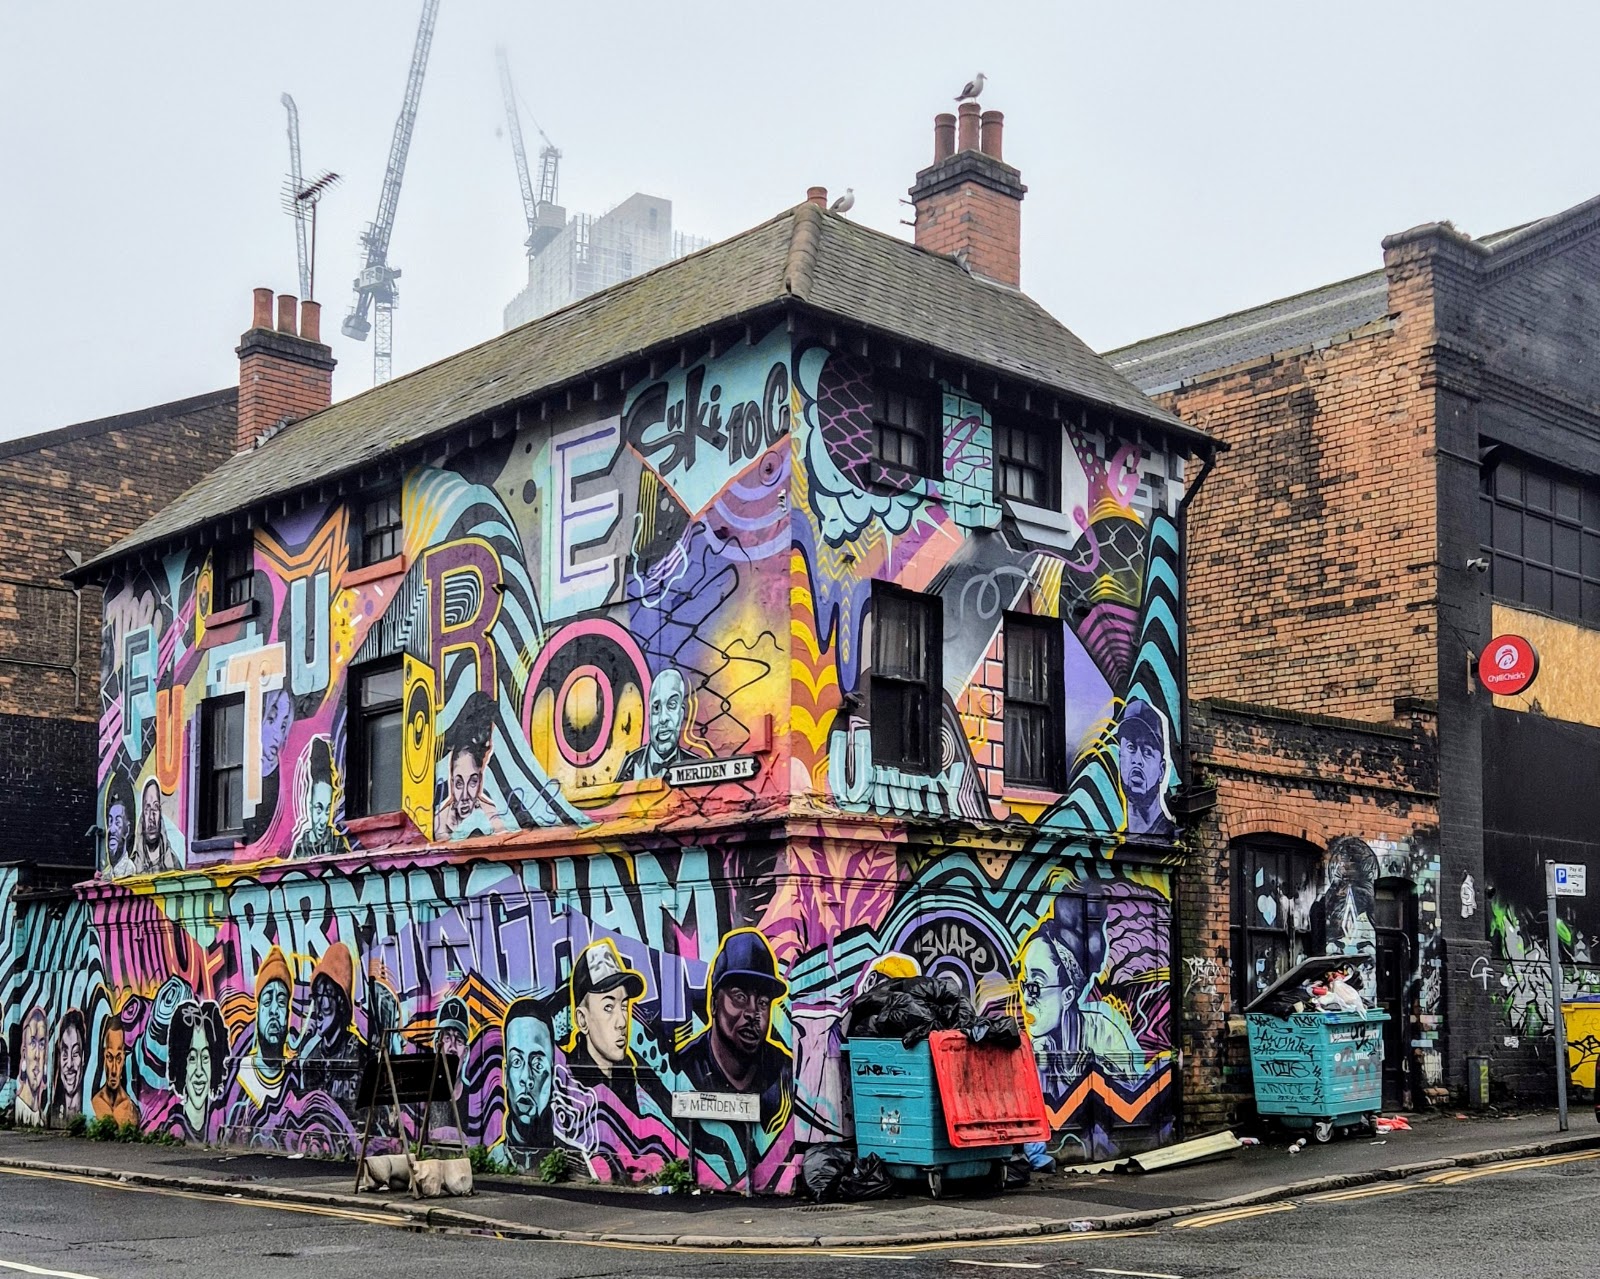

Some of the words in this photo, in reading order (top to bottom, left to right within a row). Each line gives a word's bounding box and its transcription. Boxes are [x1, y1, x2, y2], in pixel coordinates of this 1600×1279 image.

[676, 764, 727, 782] MERIDEN
[829, 730, 965, 820] UNITY
[1558, 870, 1566, 883] P
[229, 846, 720, 1021] BIRMINGHAM
[690, 1099, 736, 1113] MERIDEN
